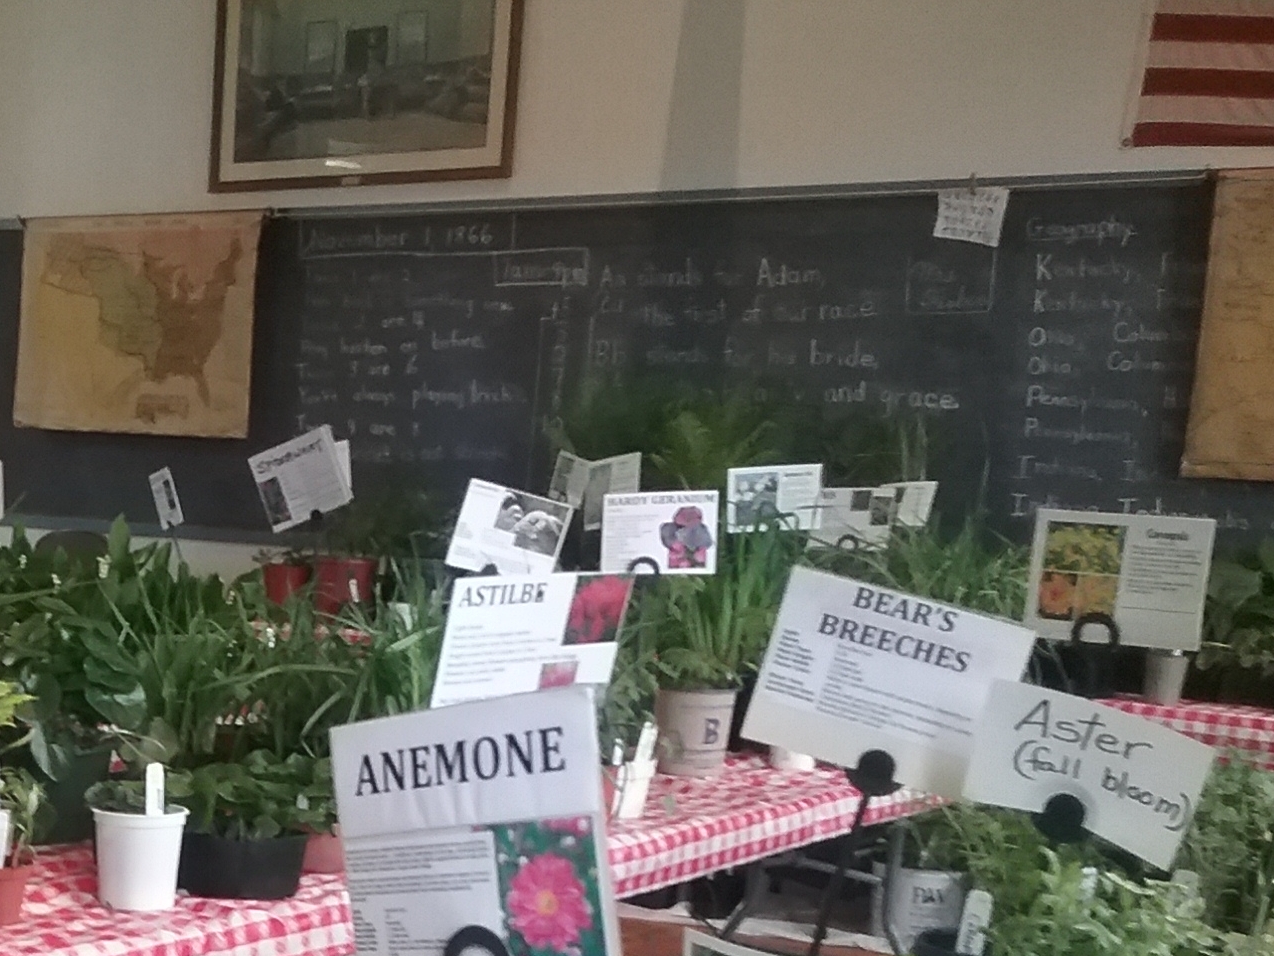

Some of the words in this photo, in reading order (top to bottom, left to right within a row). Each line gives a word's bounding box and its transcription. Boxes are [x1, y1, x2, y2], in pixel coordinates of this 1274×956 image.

[607, 495, 647, 507] HARDY
[651, 493, 715, 505] GERANIUM
[458, 583, 547, 608] ASTILBE
[852, 586, 959, 633] BEAR'S
[817, 613, 971, 673] BREECHES
[1014, 700, 1153, 759] Aster
[355, 726, 566, 797] ANEMONE
[1013, 740, 1081, 780] (fall
[1101, 767, 1192, 831] bloom)
